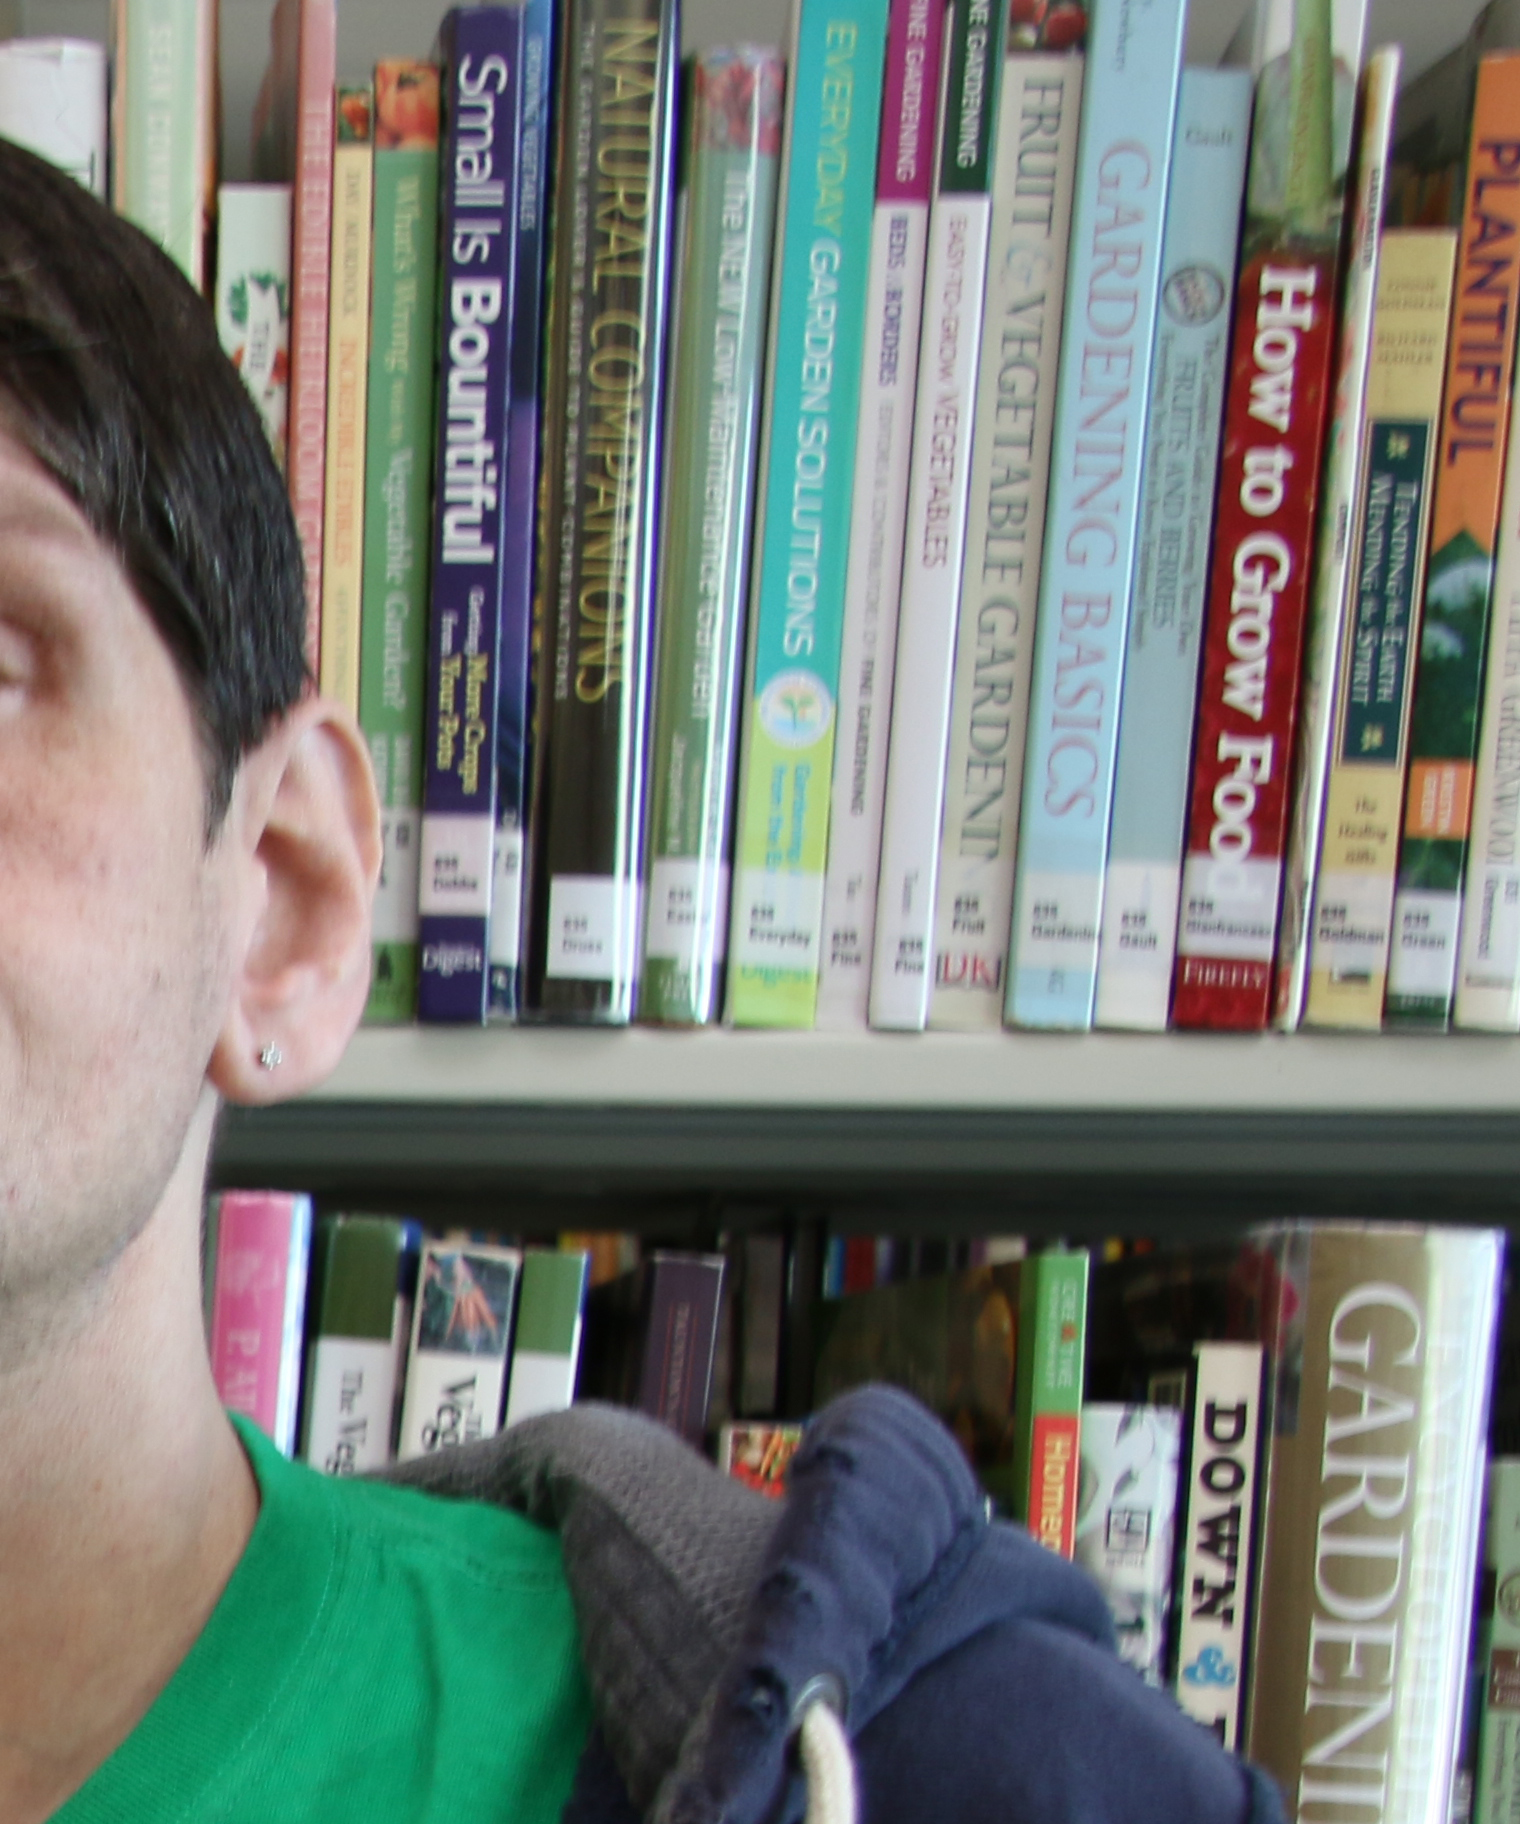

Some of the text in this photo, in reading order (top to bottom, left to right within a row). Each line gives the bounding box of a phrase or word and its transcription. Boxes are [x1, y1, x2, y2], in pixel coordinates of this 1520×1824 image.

[518, 37, 543, 231] GROWING VEGETABLES
[895, 46, 925, 183] GARDENING
[956, 33, 986, 170] GARDENING
[393, 176, 421, 273] What's
[717, 168, 751, 310] The NEW
[886, 216, 909, 269] BEDS
[385, 277, 418, 373] Wrong
[440, 52, 509, 565] Small Is Bountiful
[554, 21, 595, 700] THE GARDEN PLANT COMBINATIONS
[575, 15, 661, 703] NATURAL COMPANIONS
[782, 19, 858, 659] EVERYDAY GARDEN SOLUTIONS
[878, 287, 903, 387] BORDERS
[1448, 140, 1520, 467] PLANTIFUL
[923, 216, 970, 568] EASY-TO-GROW VEGETABLES
[383, 451, 413, 584] Vegetable
[960, 77, 1065, 863] FRUIT VEGETABLE GARDENI
[1043, 140, 1153, 817] GARDENING BASICS
[1152, 360, 1198, 629] FRUITS AND BERRIES
[1209, 265, 1318, 863] How to Grow Foo
[1350, 472, 1394, 706] MENDING SPIRIT
[1375, 480, 1418, 703] TENDING EARTH
[382, 591, 411, 711] Garden?
[436, 610, 462, 770] from Your Pots
[459, 586, 489, 795] Getting More Crops
[787, 763, 811, 863] Gardening
[849, 705, 874, 816] GARDENING
[420, 949, 483, 973] Digest
[749, 926, 811, 949] Everyday
[831, 951, 862, 967] Fine
[951, 916, 986, 937] Fruit
[1181, 959, 1269, 989] FIREFLY
[1318, 926, 1386, 945] Goldman
[1401, 931, 1447, 952] Green
[340, 1372, 363, 1414] The
[1191, 1399, 1249, 1629] DOWN
